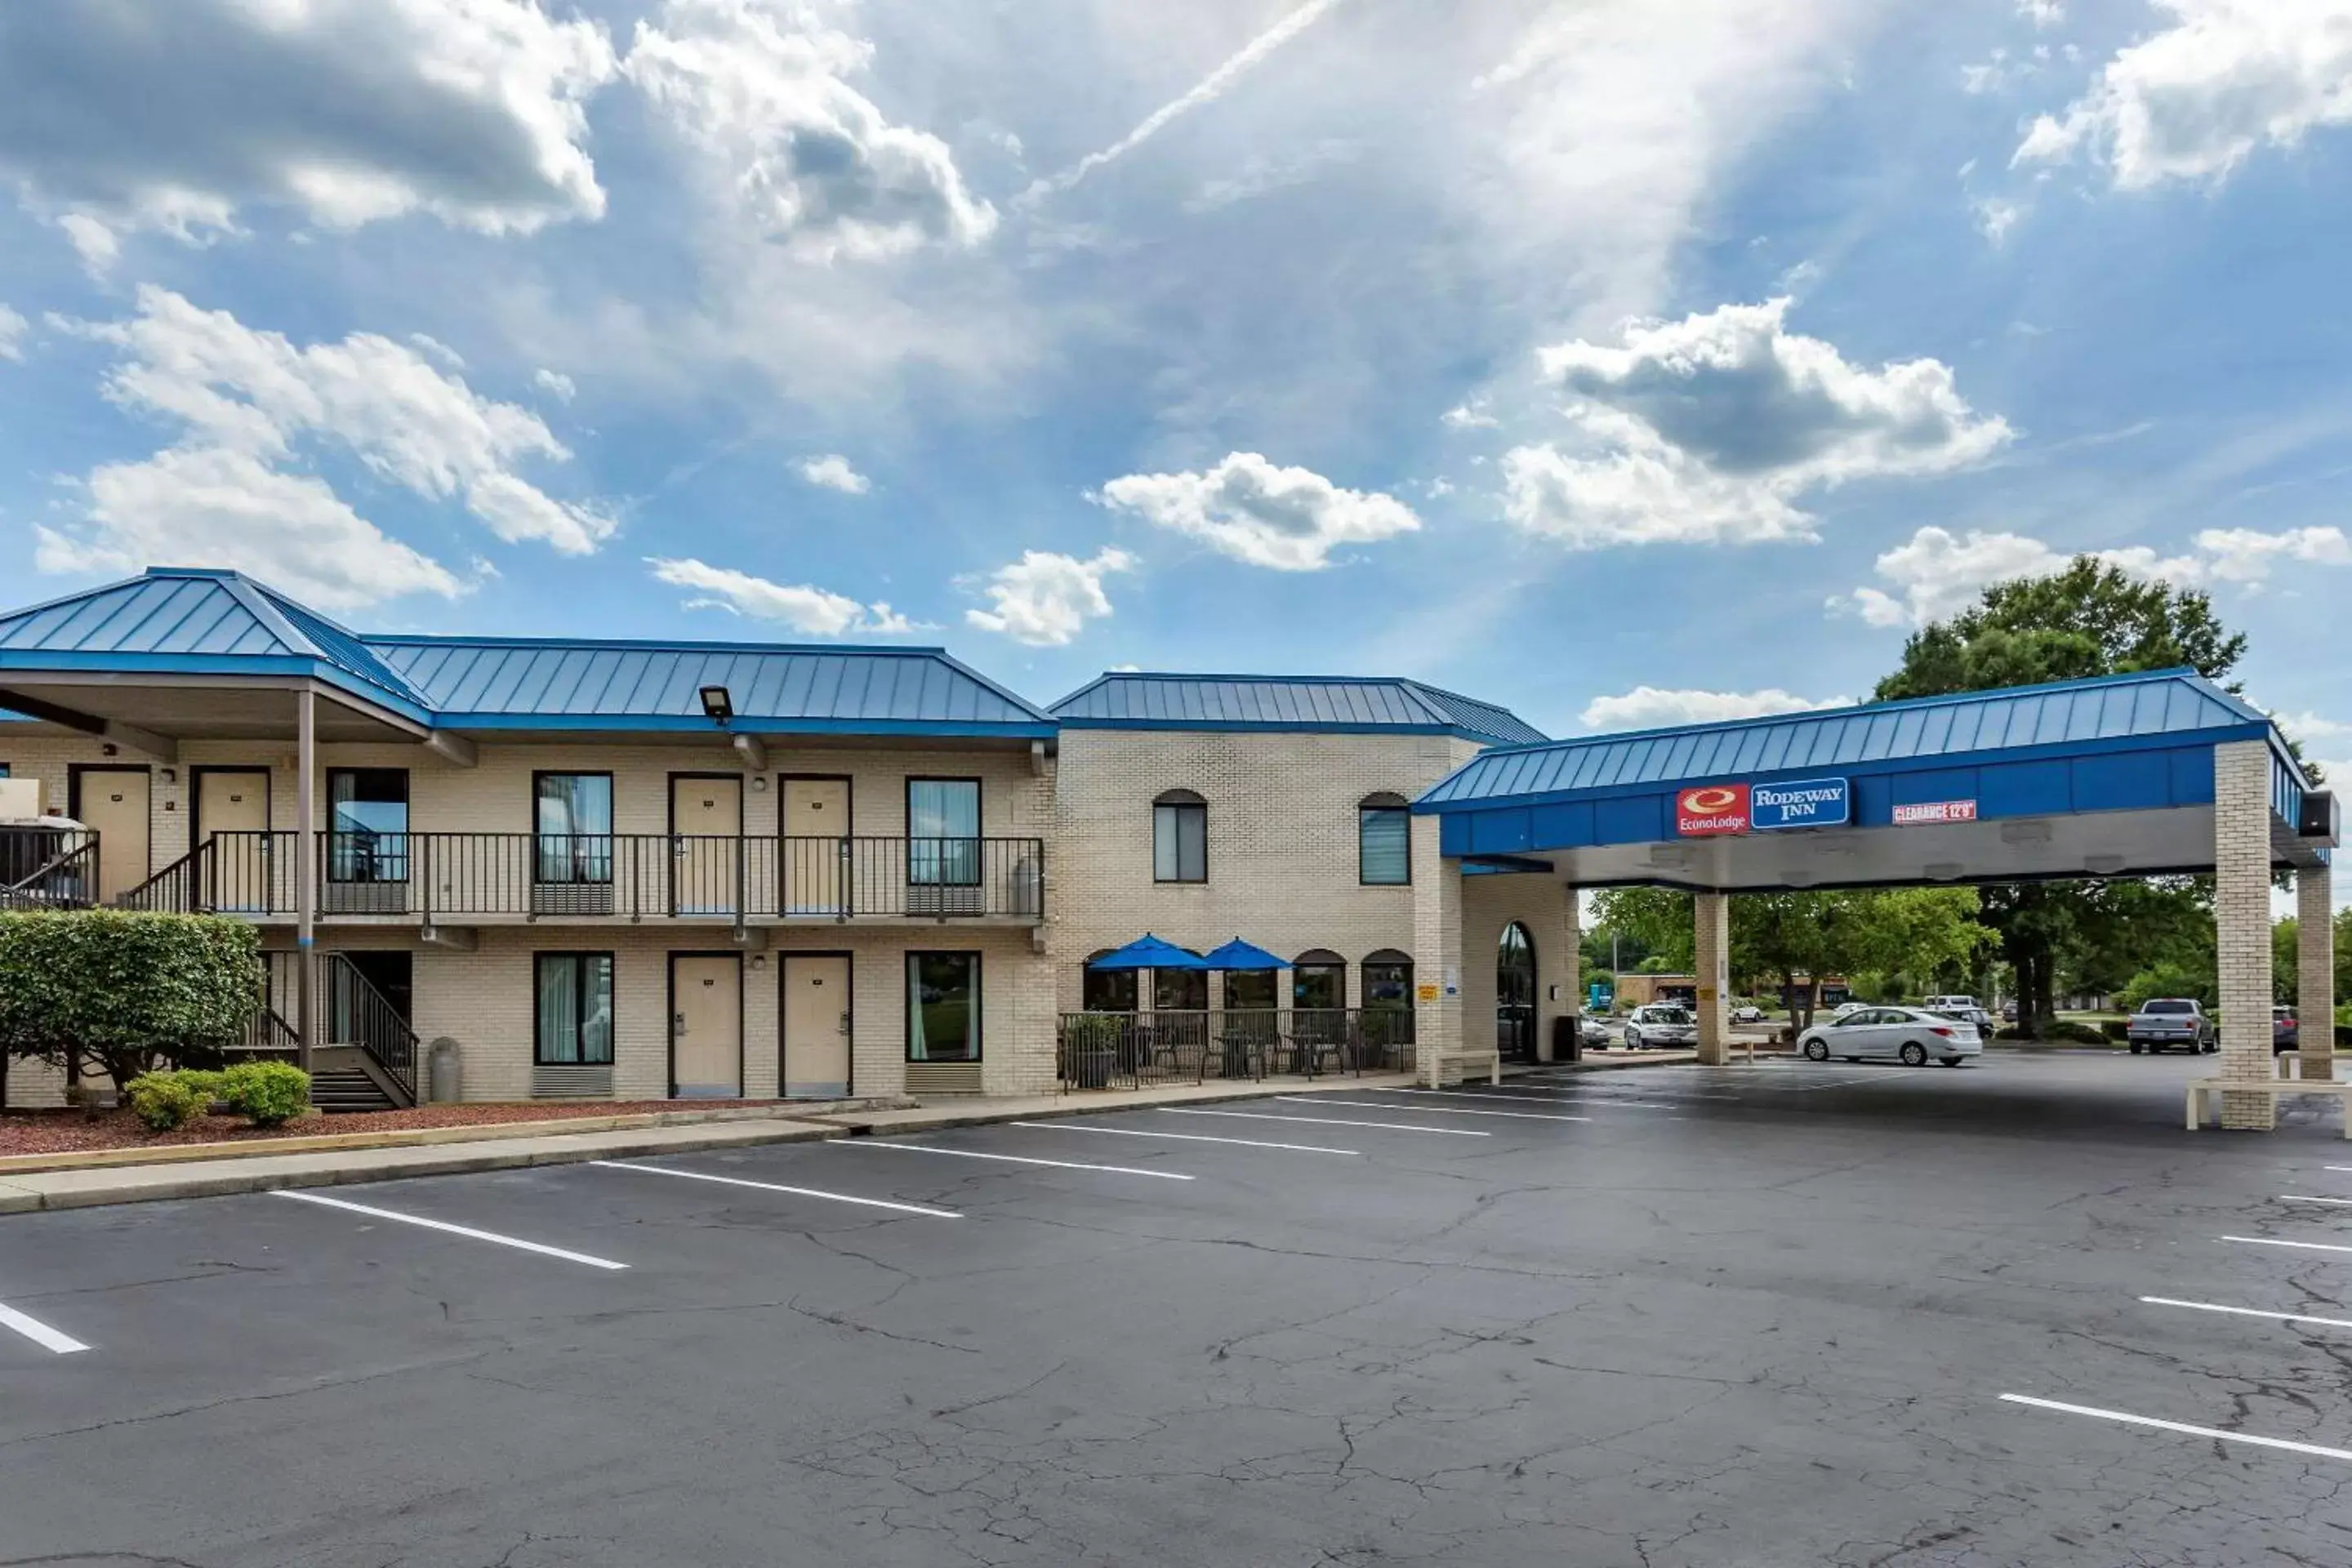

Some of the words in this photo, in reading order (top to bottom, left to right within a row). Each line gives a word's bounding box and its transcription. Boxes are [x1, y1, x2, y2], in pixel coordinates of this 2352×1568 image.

[1757, 787, 1843, 806] RODEWAY
[1780, 803, 1816, 821] INN
[1895, 804, 1949, 821] CLEARANCE
[1680, 815, 1746, 831] EconoLodge
